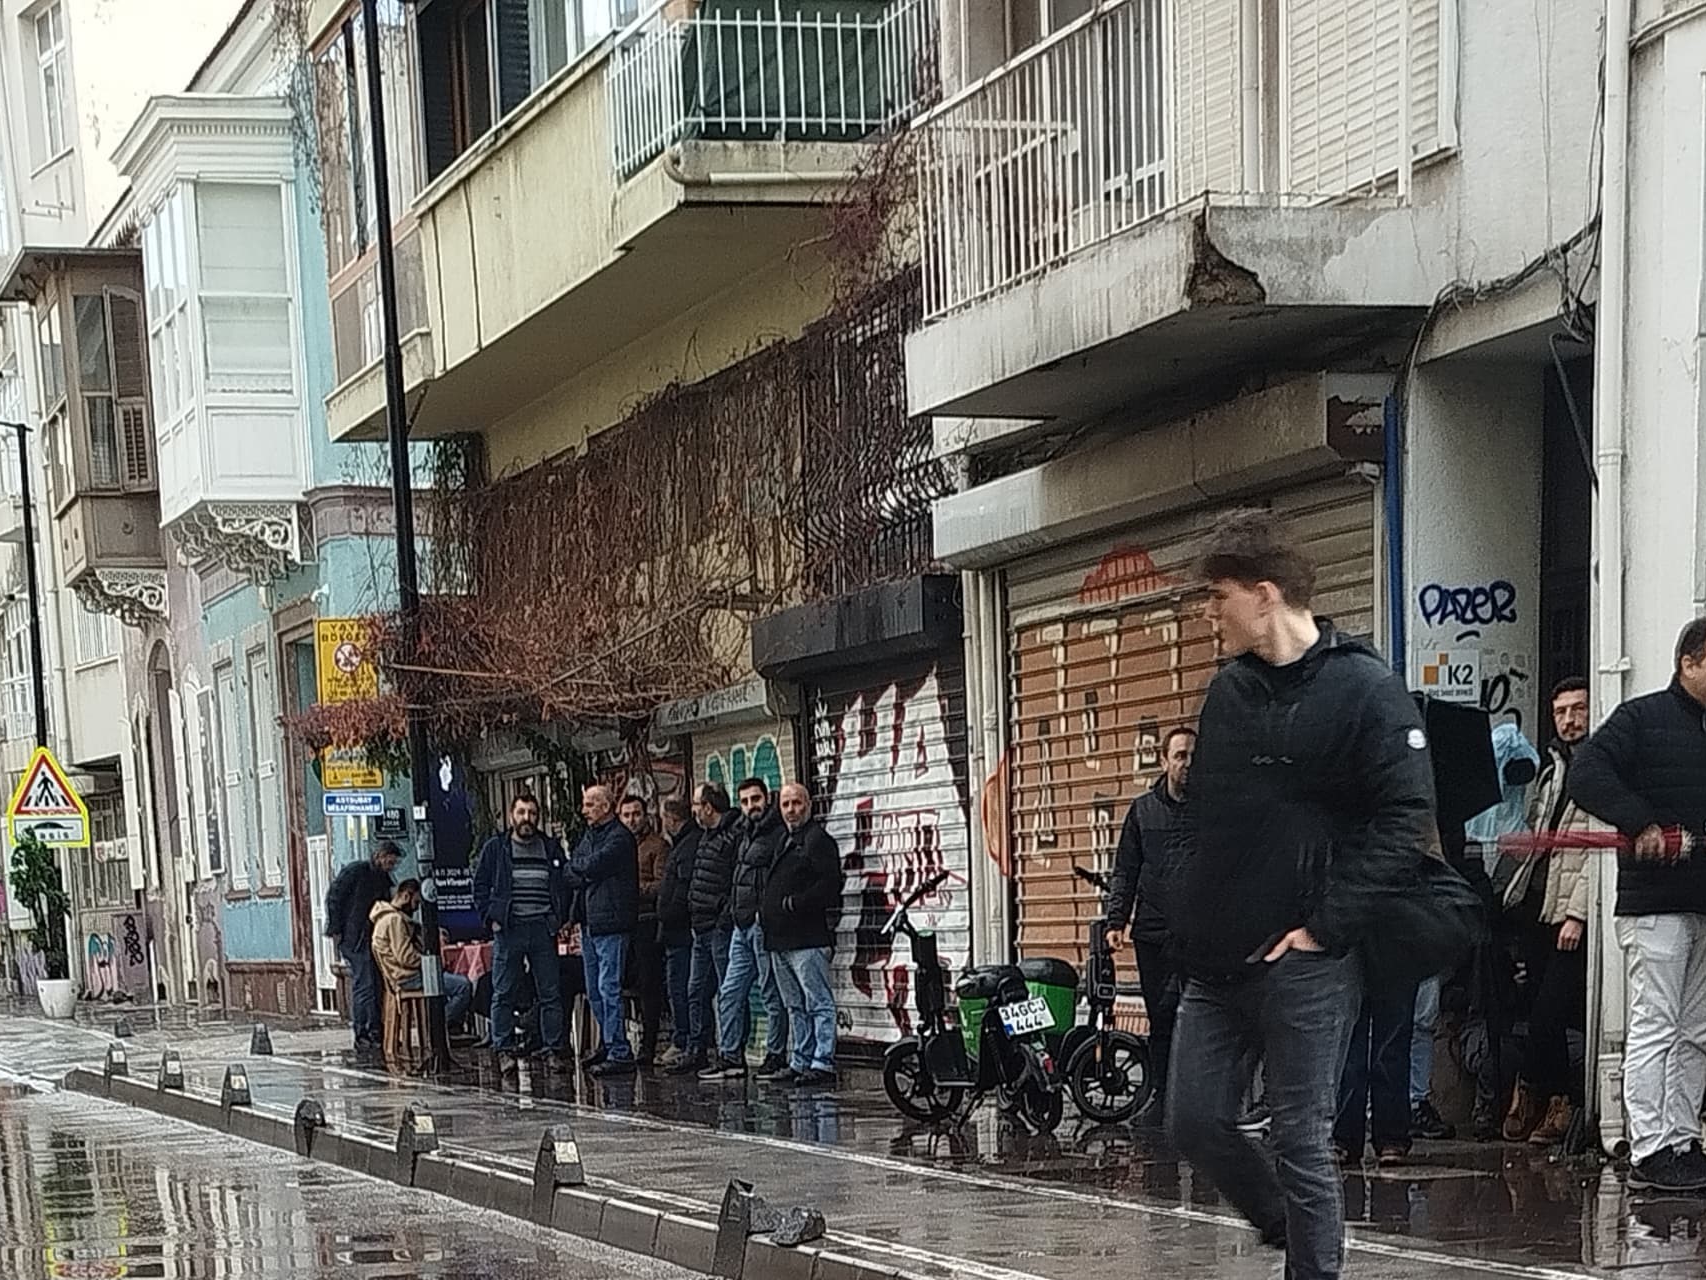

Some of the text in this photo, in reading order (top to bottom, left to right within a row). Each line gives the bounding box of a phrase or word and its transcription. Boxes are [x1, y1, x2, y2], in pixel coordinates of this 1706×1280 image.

[1448, 664, 1474, 686] K2
[39, 831, 70, 840] asis
[1016, 1015, 1043, 1032] 444
